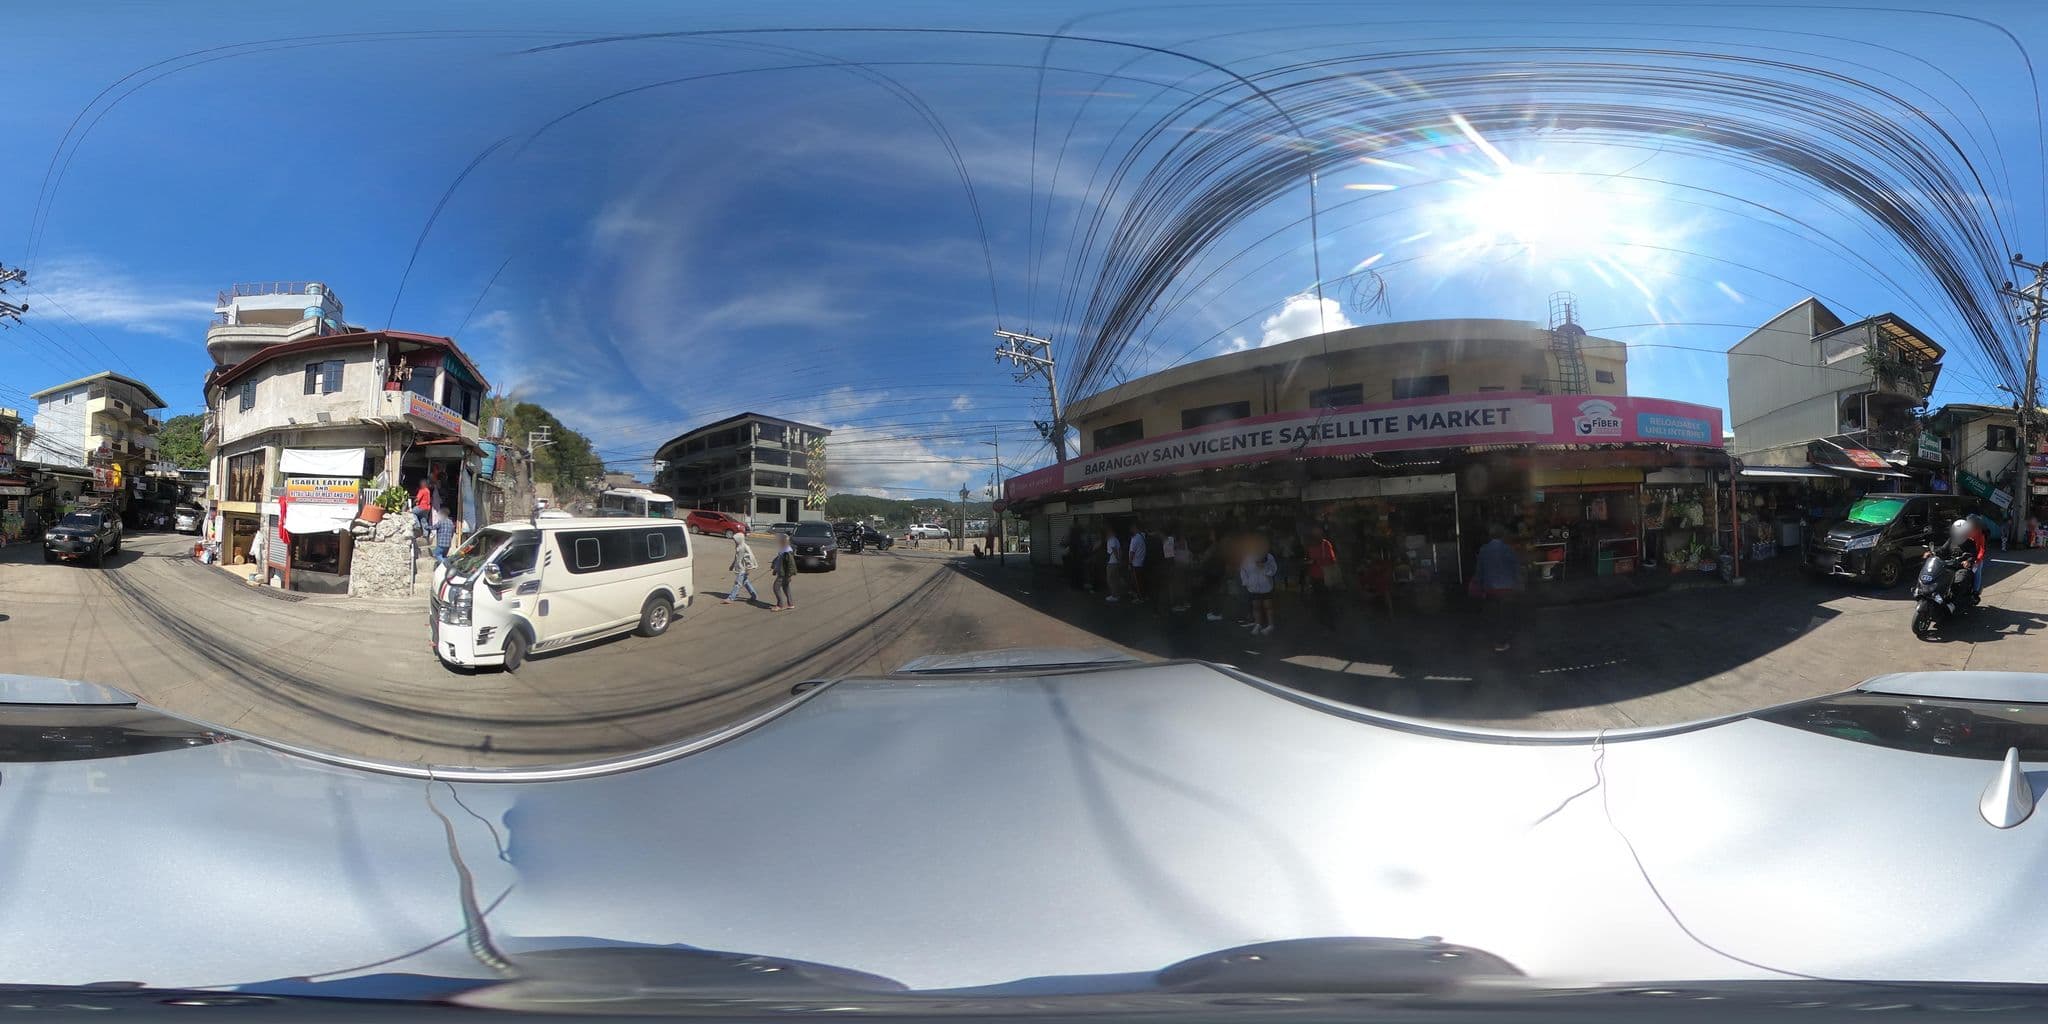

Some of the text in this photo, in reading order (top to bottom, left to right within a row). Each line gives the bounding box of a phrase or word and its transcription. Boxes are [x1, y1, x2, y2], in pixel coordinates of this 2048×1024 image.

[1650, 418, 1701, 429] RELOADABLE
[1668, 428, 1704, 439] INTERNET
[1085, 408, 1511, 475] BARANGAY SAN VICENTE SATELLITE MARKET
